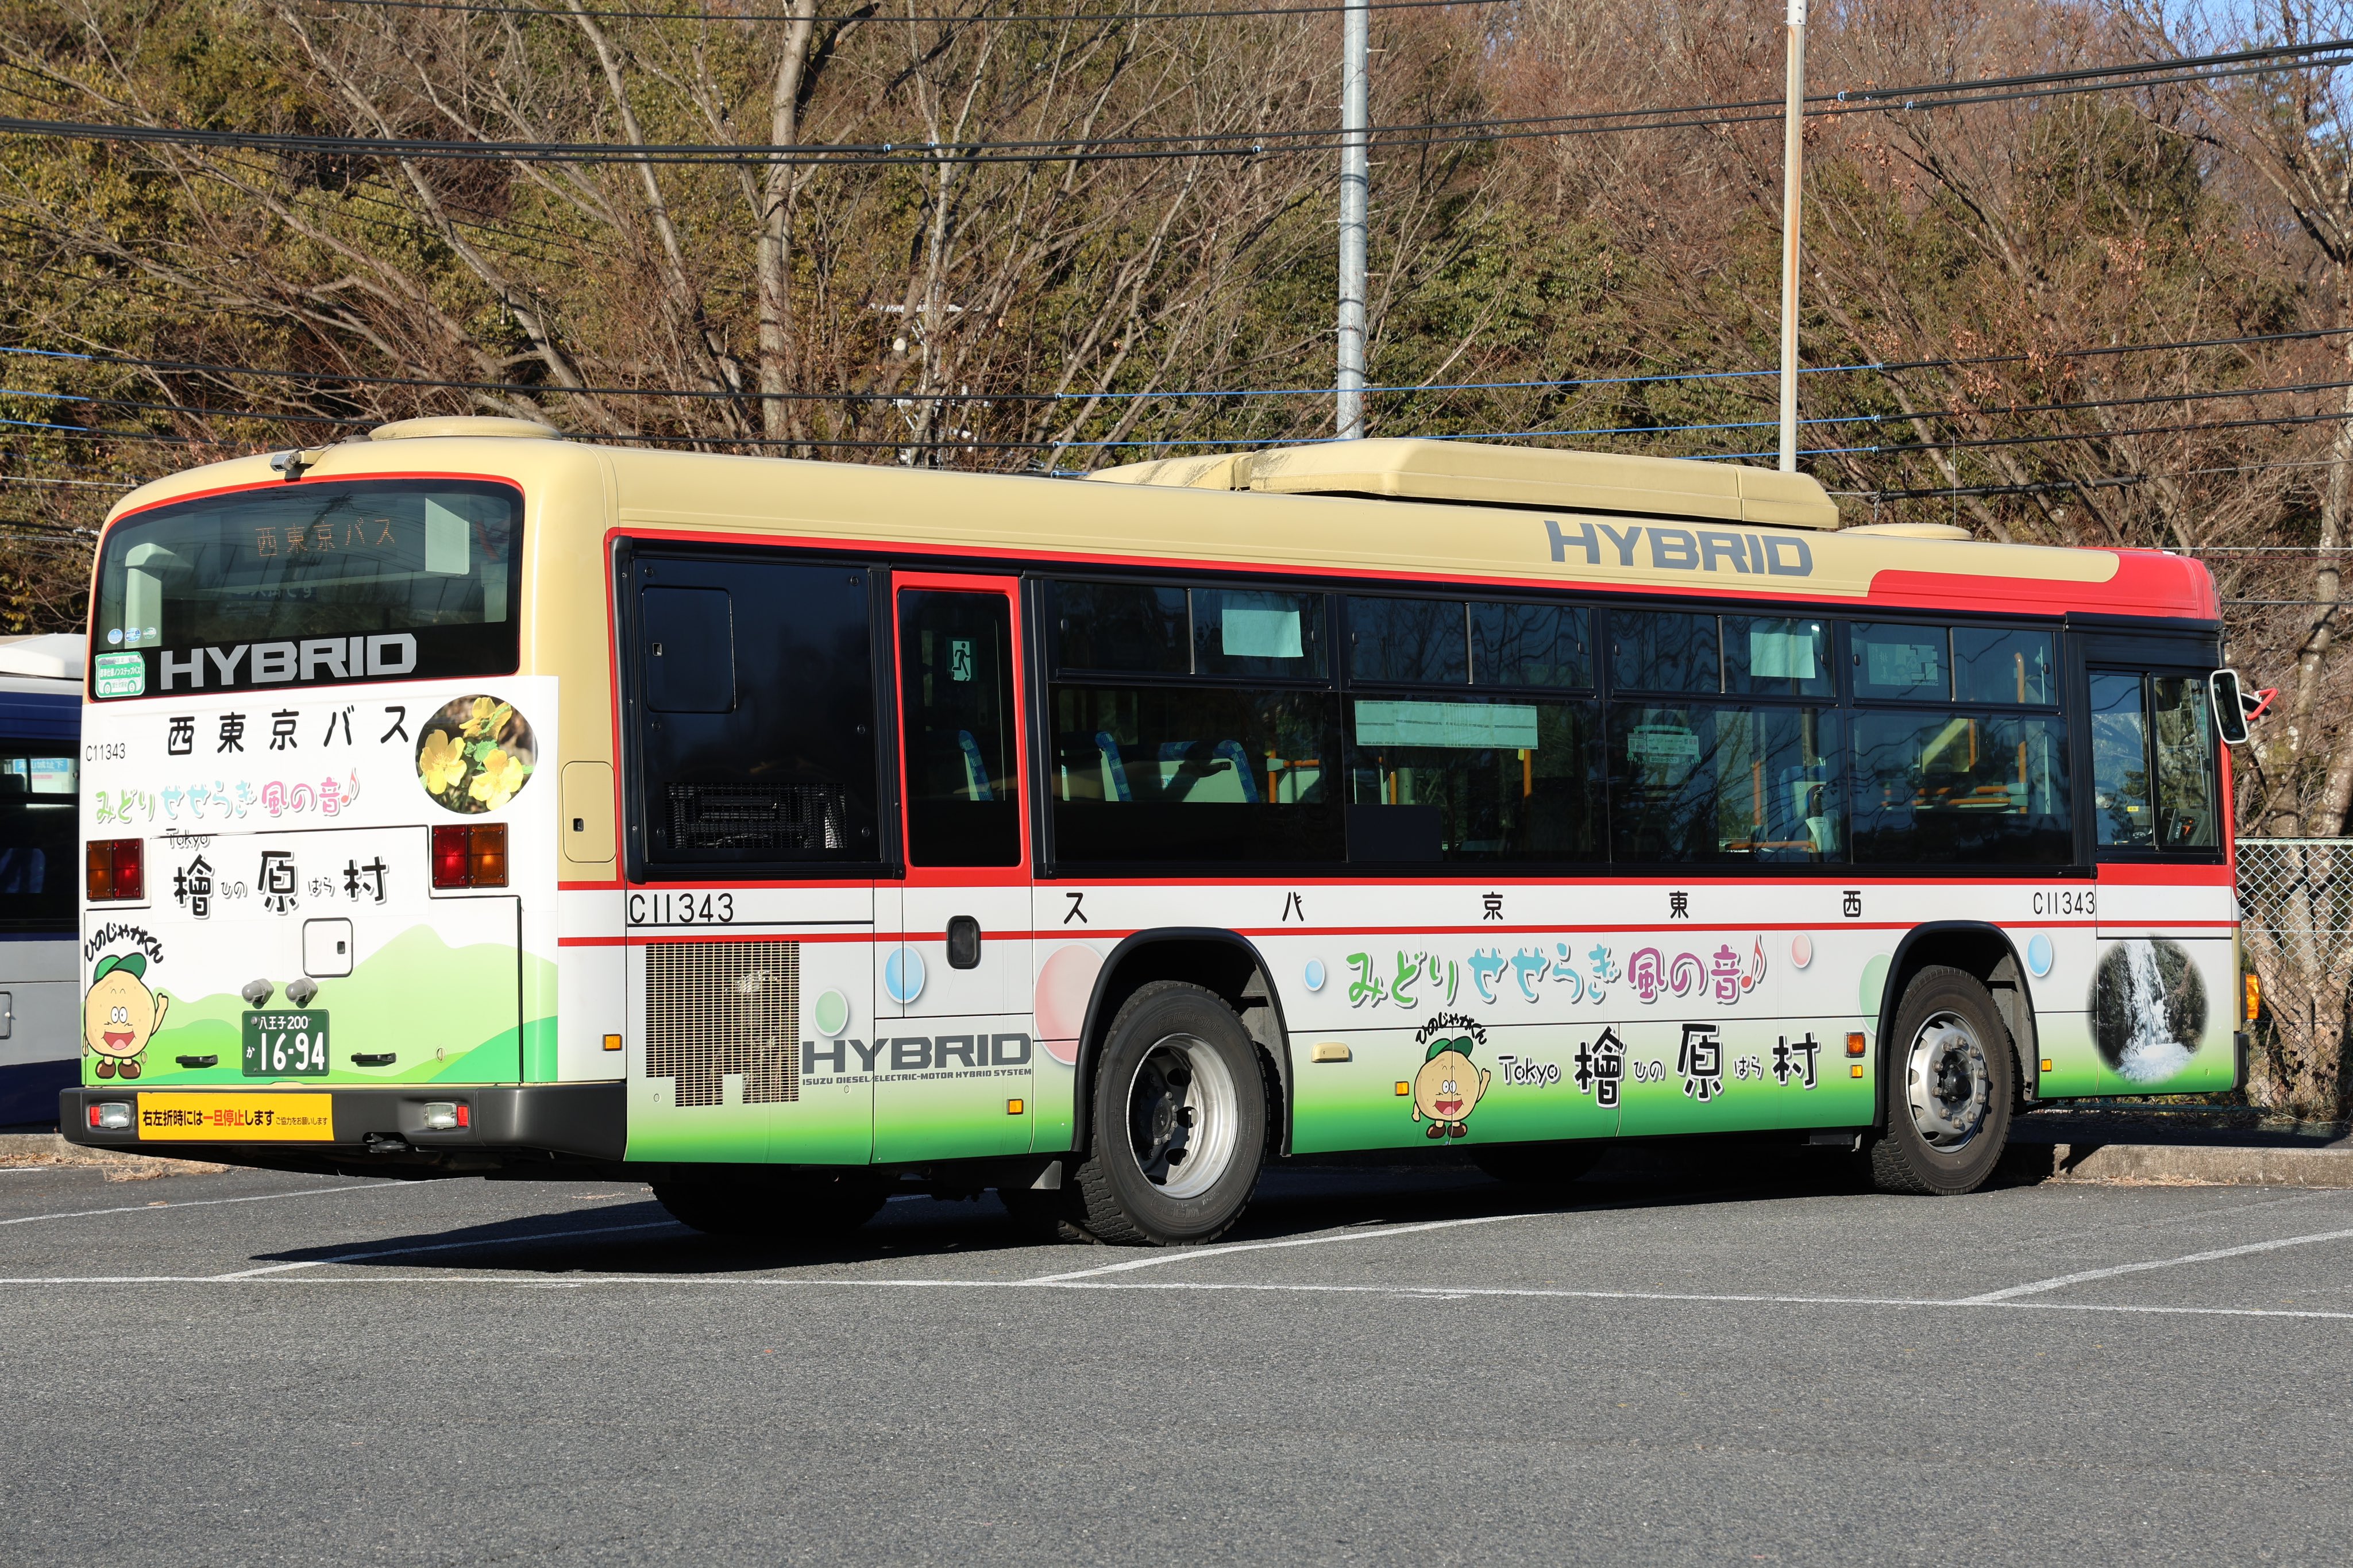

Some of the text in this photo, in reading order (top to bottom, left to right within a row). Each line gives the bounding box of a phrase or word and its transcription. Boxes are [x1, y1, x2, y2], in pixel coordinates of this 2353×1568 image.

[255, 517, 395, 557] 西東京バス
[1544, 520, 1813, 577] HYBRID
[161, 634, 416, 689] HYBRID
[168, 705, 410, 756] 西東京バス
[86, 743, 126, 762] C11343
[95, 776, 341, 824] みどり せせらぎ 風の音
[165, 828, 210, 850] Tokyo
[629, 893, 734, 924] C11343
[2033, 891, 2095, 915] C11343
[85, 922, 164, 963] ひのじゃがくん
[1346, 943, 1743, 1007] みどり せせらぎ 風の音
[1415, 1011, 1487, 1045] ひのじゃがくん
[246, 1032, 325, 1071] か 16-94
[803, 1033, 1032, 1074] HYBRID
[802, 1077, 833, 1086] ISUZU
[956, 1070, 992, 1078] HYBRID
[994, 1068, 1032, 1076] SYSTEM
[1498, 1055, 1561, 1088] Tokyo
[142, 1110, 328, 1126] 右左折時には一旦停止します ご協力をお願いします
